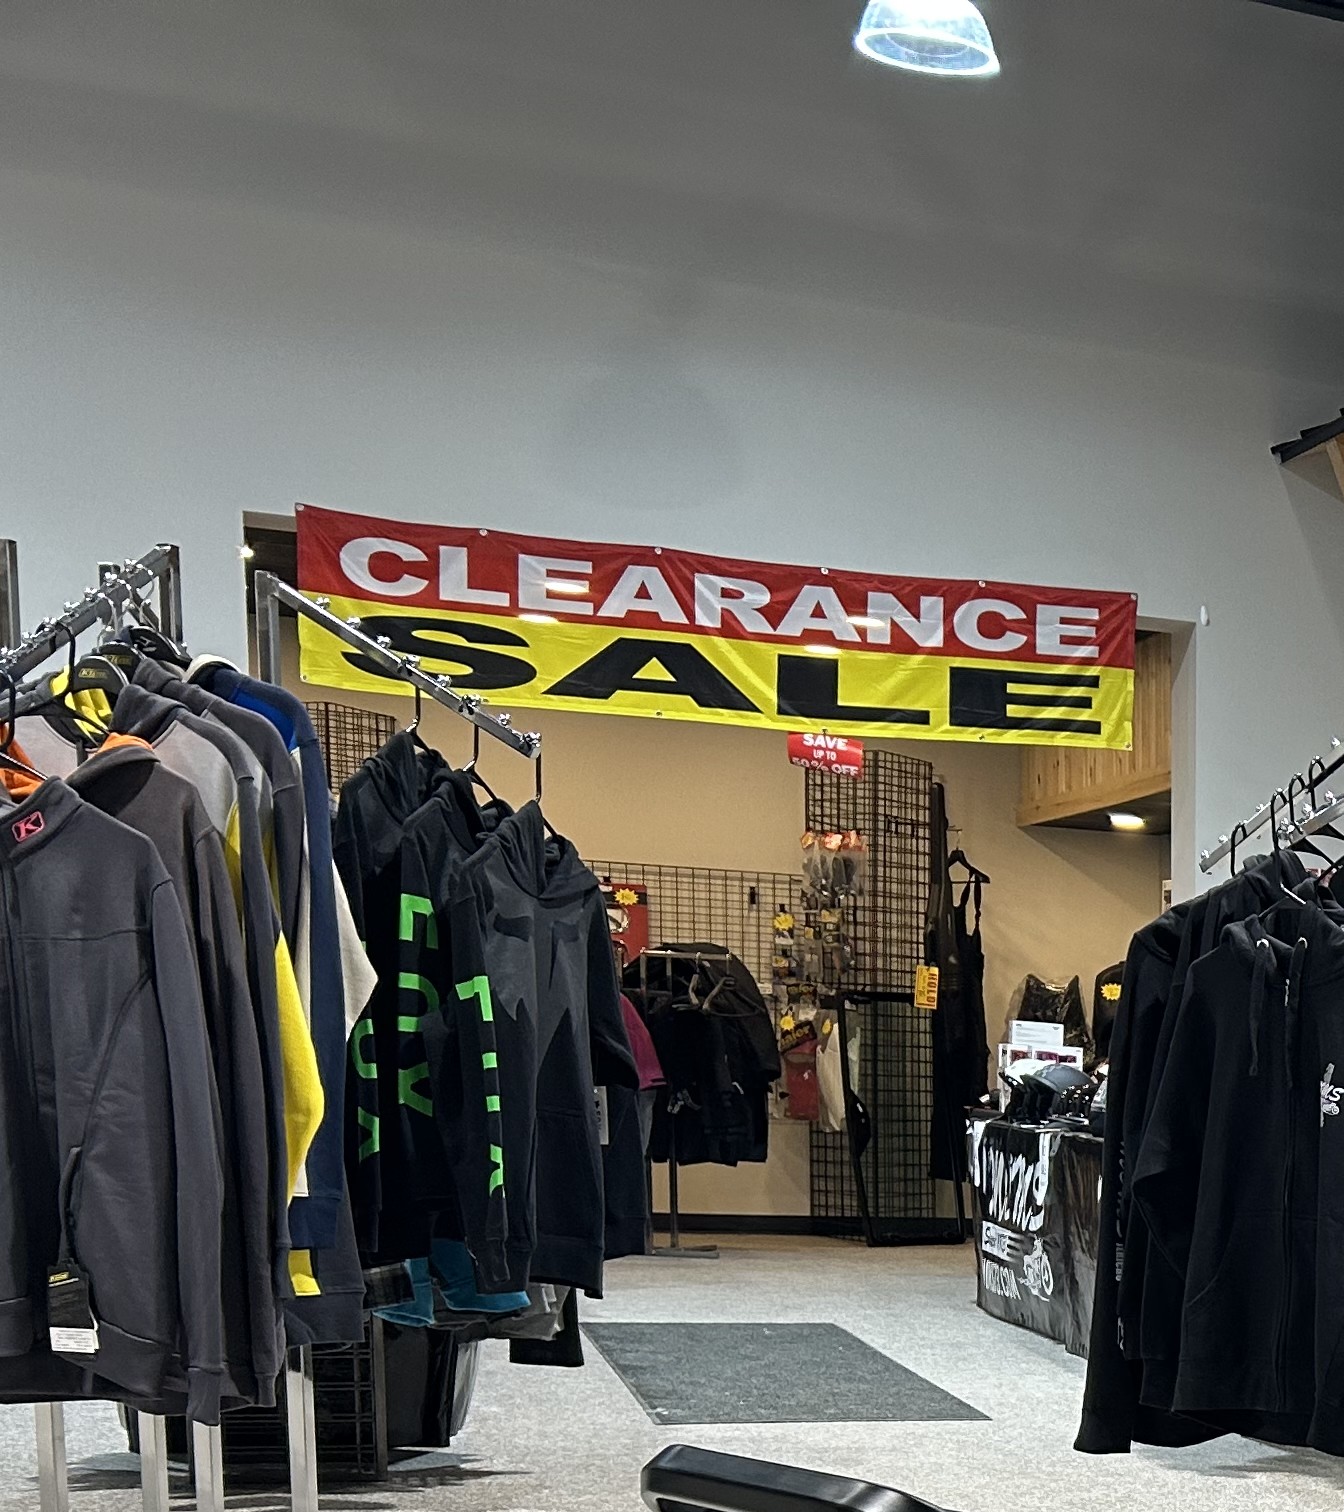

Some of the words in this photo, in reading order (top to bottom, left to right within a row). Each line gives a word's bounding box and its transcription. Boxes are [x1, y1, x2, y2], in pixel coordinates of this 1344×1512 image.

[339, 536, 1099, 658] CLEARANCE
[341, 615, 1101, 735] SALE
[803, 734, 848, 750] SAVE
[813, 749, 824, 758] UP
[826, 751, 836, 760] TO
[831, 764, 859, 776] OFF
